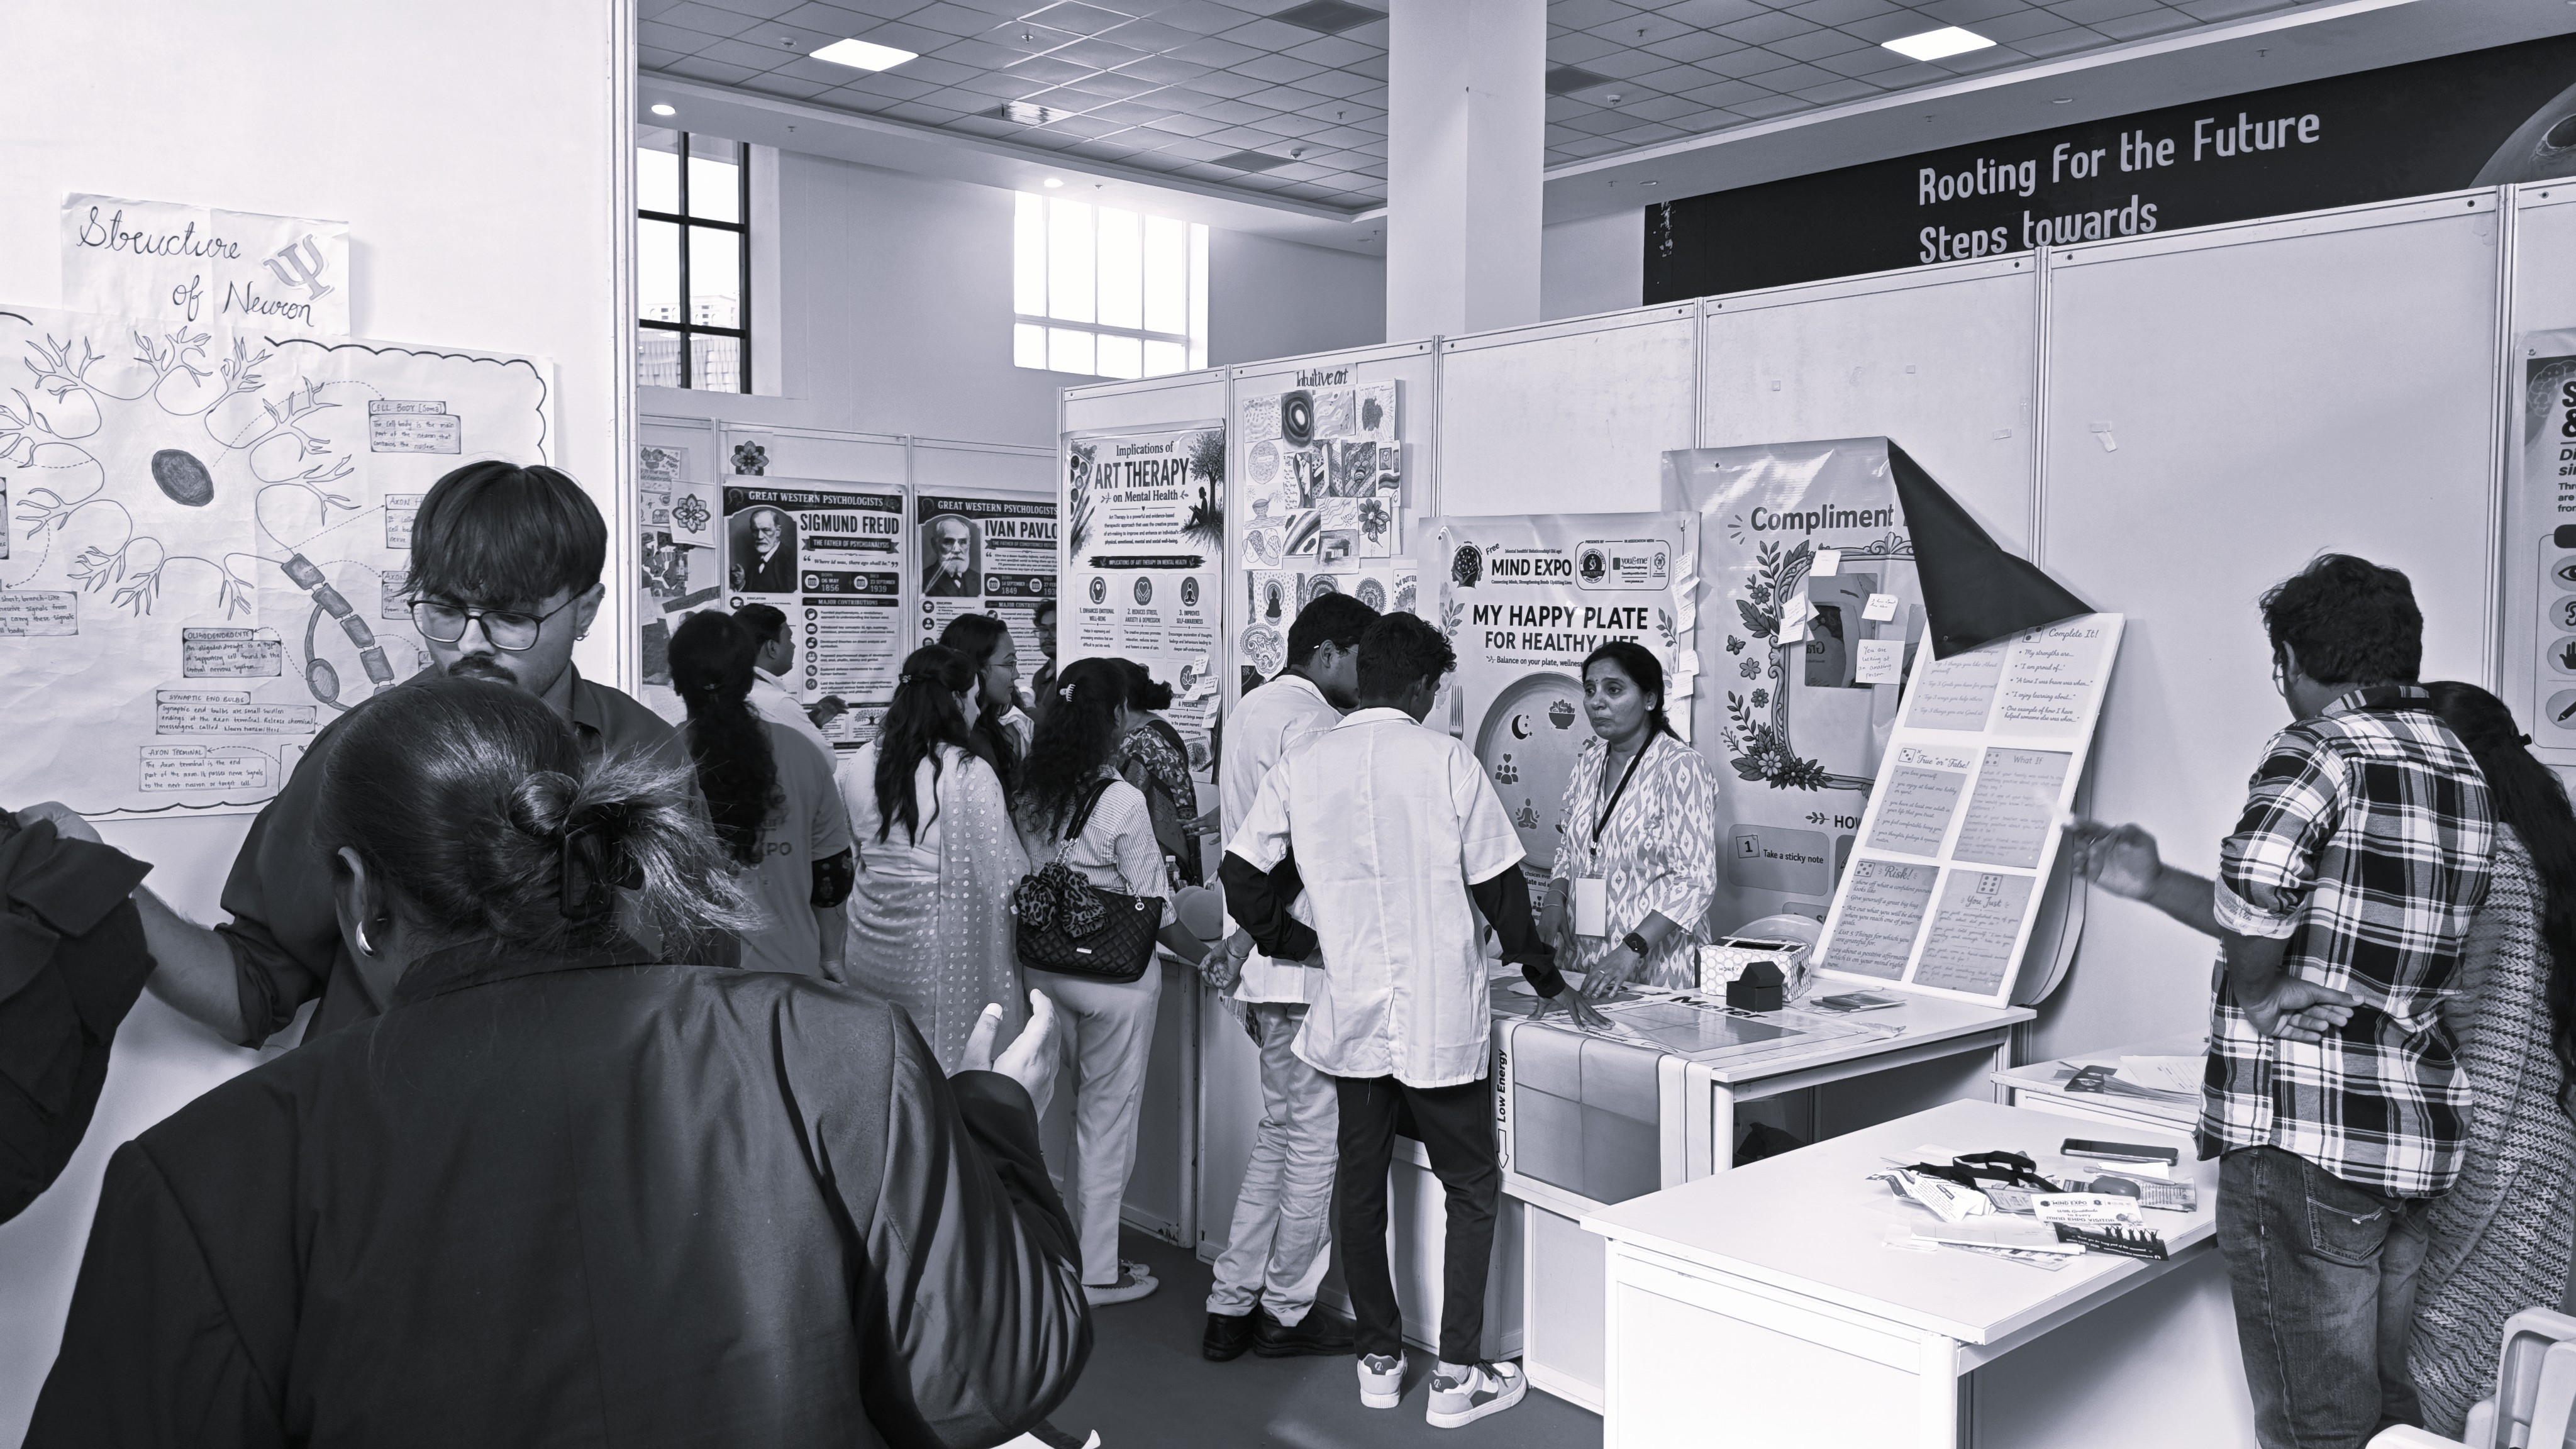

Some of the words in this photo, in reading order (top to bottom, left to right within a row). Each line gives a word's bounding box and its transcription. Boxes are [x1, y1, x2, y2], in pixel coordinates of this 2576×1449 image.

[1919, 157, 2036, 206] Rooting
[2120, 130, 2175, 172] the
[2194, 112, 2319, 162] Future
[77, 206, 241, 258] Structure
[1920, 225, 2007, 264] Steps
[2023, 194, 2157, 248] towards
[172, 275, 203, 321] of
[223, 280, 315, 327] Neuron
[1297, 369, 1333, 387] Intuitive
[1335, 369, 1348, 385] art
[1116, 443, 1163, 458] Implications
[1165, 441, 1174, 452] of
[1094, 462, 1121, 489] ART
[1124, 458, 1189, 487] THERAPY
[748, 491, 778, 501] GREAT
[780, 492, 820, 503] WESTERN
[823, 494, 883, 506] PSYCHOLOGISTS
[1113, 494, 1123, 502] on
[1124, 491, 1151, 502] Mental
[1153, 489, 1178, 501] Health
[938, 501, 963, 511] GREAT
[965, 502, 1002, 512] WESTERN
[800, 514, 858, 533] SIGMUND
[862, 516, 899, 535] FREUD
[1751, 503, 1894, 535] Compliment
[985, 520, 1016, 537] IVAN
[850, 540, 889, 548] PSYCHOANALYSIS
[1485, 543, 1500, 555] Free
[1492, 559, 1531, 576] MIND
[1535, 559, 1572, 576] EXPO
[1473, 604, 1503, 626] MY
[1509, 605, 1578, 628] HAPPY
[1584, 607, 1648, 630] PLATE
[2048, 628, 2082, 641] Complete
[2084, 630, 2099, 638] It!
[1485, 631, 1516, 649] FOR
[1523, 633, 1597, 653] HEALTHY
[2024, 649, 2035, 658] My
[2036, 650, 2059, 658] strengths
[1541, 658, 1558, 667] plate,
[2035, 663, 2051, 672] proud
[2033, 692, 2053, 701] learning
[163, 706, 190, 714] Synaptic
[2004, 713, 2019, 721] helped
[2038, 706, 2045, 714] of
[1917, 755, 1933, 764] True
[1948, 758, 1970, 769] False!
[2014, 755, 2033, 764] What
[2035, 757, 2044, 765] If
[1745, 841, 1753, 852] 1
[1763, 849, 1778, 859] Take
[1785, 853, 1806, 863] sticky
[1807, 855, 1824, 863] note
[1885, 865, 1913, 880] Risk!
[1965, 895, 1982, 907] You
[1983, 896, 2002, 908] Just
[1844, 938, 1866, 947] grateful
[1855, 931, 1873, 940] Things
[1497, 1048, 1507, 1093] Energy
[1497, 1096, 1506, 1123] Low
